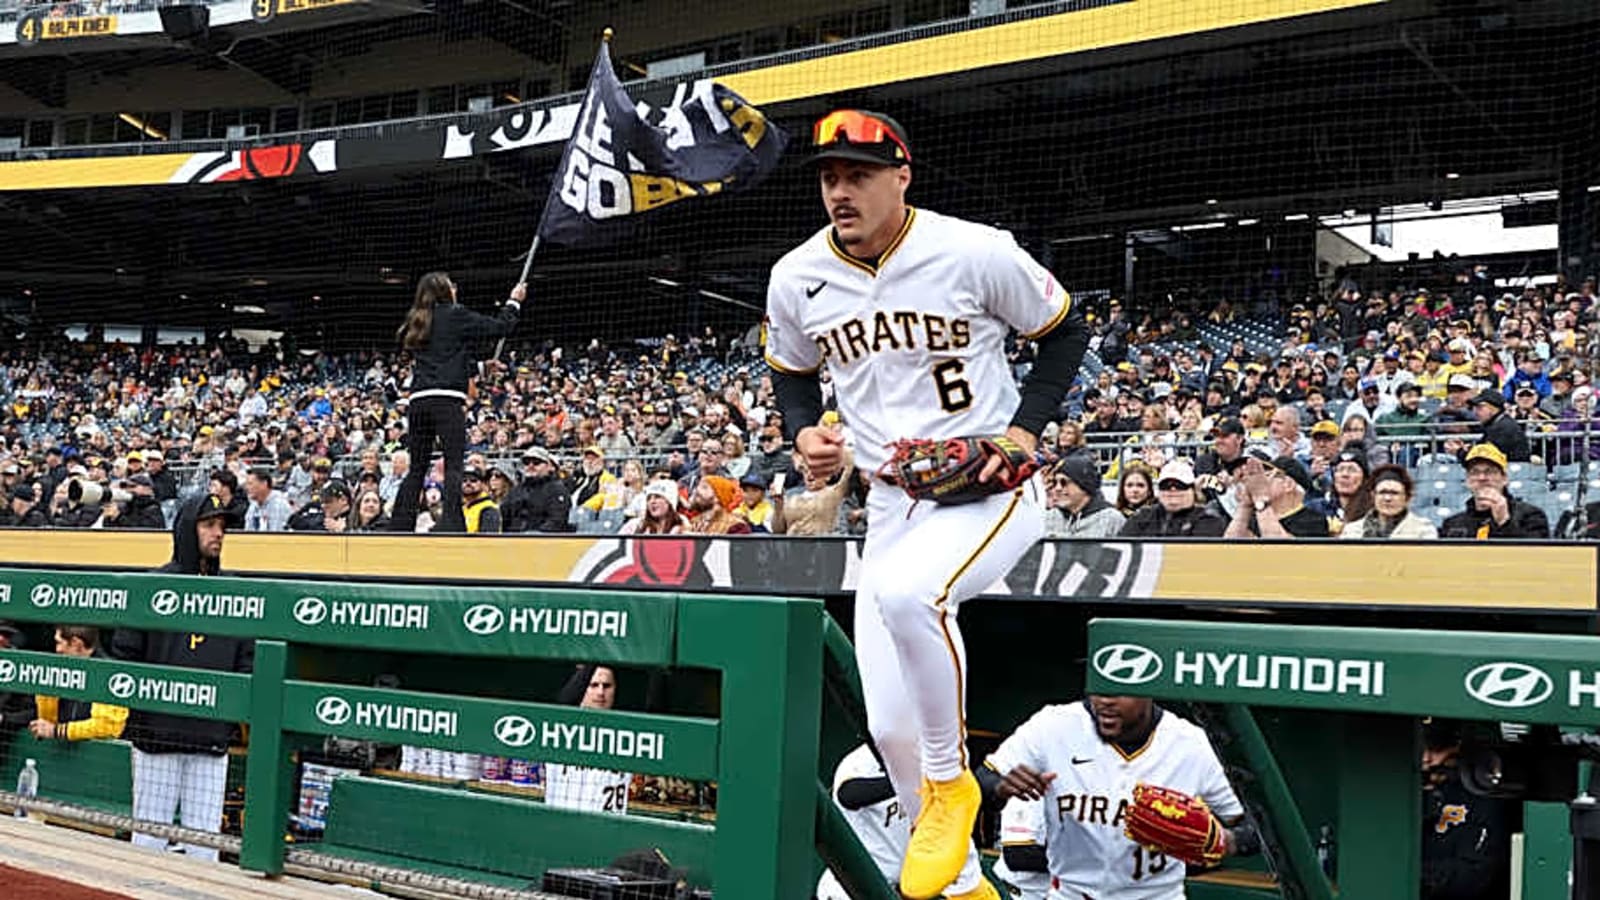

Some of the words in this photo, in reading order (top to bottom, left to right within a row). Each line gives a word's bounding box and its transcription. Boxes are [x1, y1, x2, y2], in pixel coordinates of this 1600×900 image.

[21, 18, 34, 41] 4
[560, 147, 632, 220] GO
[932, 357, 974, 414] 6
[57, 588, 128, 610] HYUNDAI
[183, 594, 265, 619] HYUNDAI
[331, 602, 429, 630] HYUNDAI
[509, 608, 628, 637] HYUNDAI
[18, 664, 86, 690] HYUNDAI
[1174, 651, 1385, 696] HYUNDAI
[138, 678, 217, 707] HYUNDAI
[356, 702, 458, 736] HYUNDAI
[541, 722, 664, 760] HYUNDAI
[602, 783, 627, 811] 28
[1056, 793, 1129, 828] PIRA
